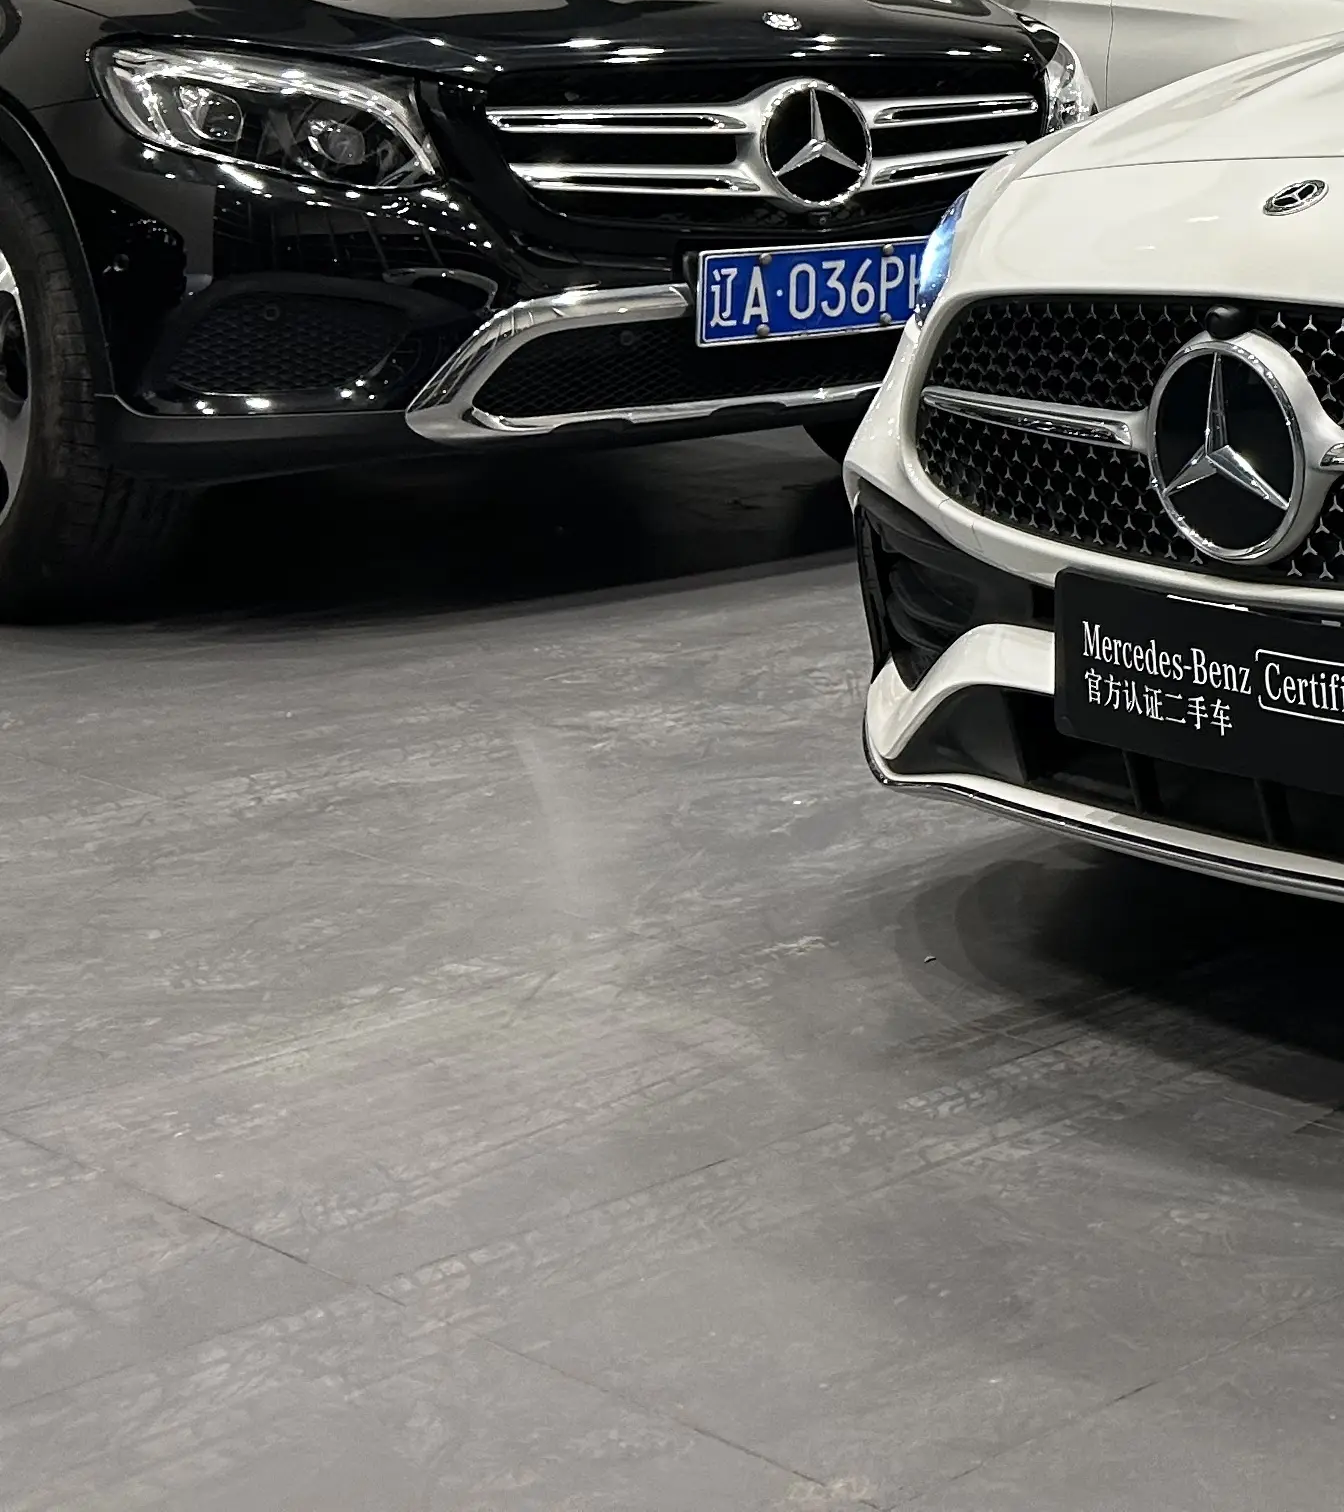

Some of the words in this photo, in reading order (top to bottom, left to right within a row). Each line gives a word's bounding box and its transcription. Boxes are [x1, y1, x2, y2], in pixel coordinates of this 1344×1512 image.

[1082, 620, 1252, 695] Mercedes-Benz
[1084, 667, 1234, 736] 官方认证二手车
